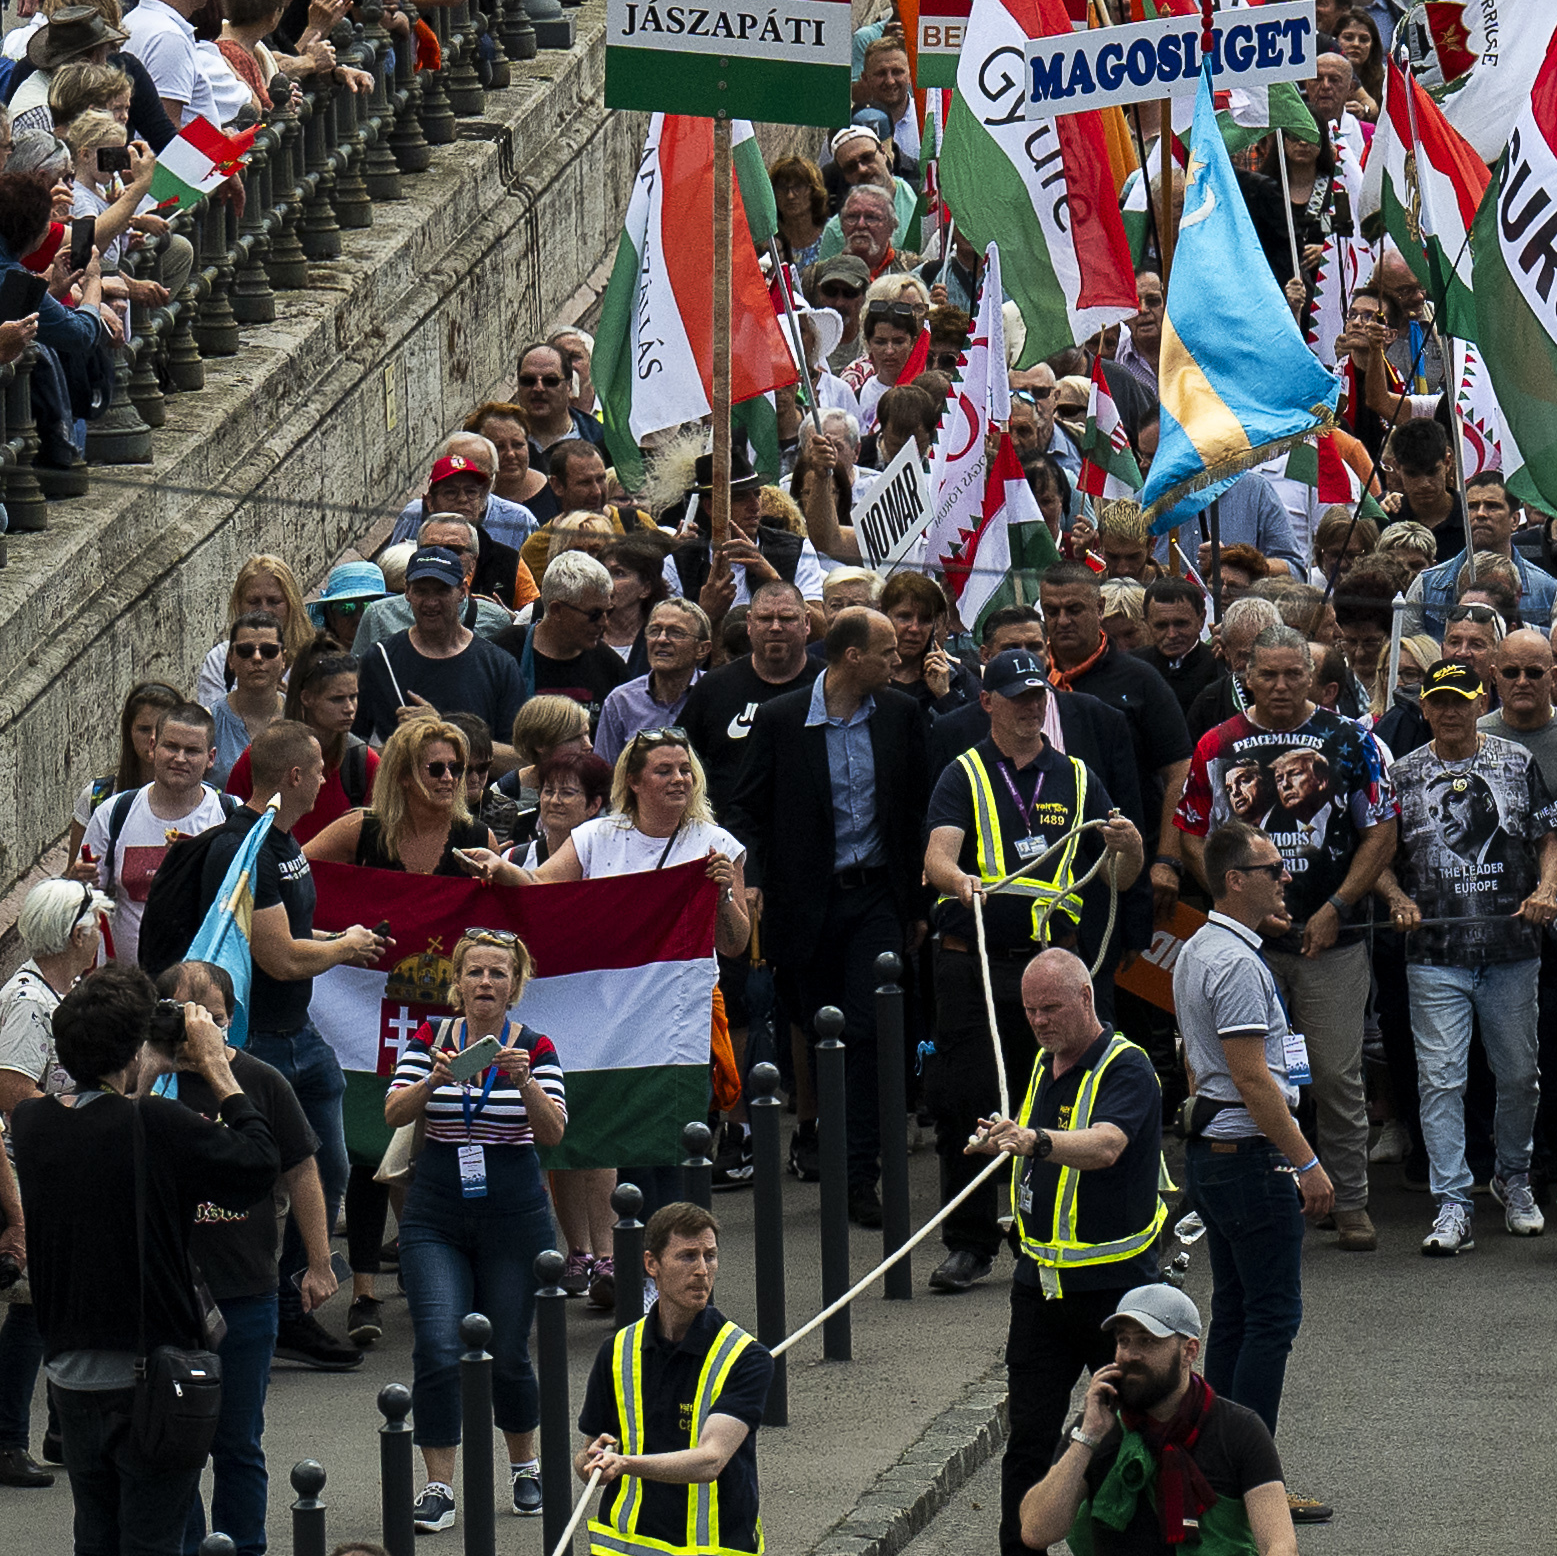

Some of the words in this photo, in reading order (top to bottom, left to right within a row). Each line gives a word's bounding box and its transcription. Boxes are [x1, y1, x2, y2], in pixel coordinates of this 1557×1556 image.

[1030, 15, 1312, 104] MAGOSLIGET
[860, 506, 889, 571] NO
[880, 461, 925, 546] WAR
[1232, 733, 1325, 754] PEACEMAKERS
[1439, 865, 1461, 880] THE
[1461, 862, 1504, 878] LEADER
[1454, 880, 1498, 896] EUROPE
